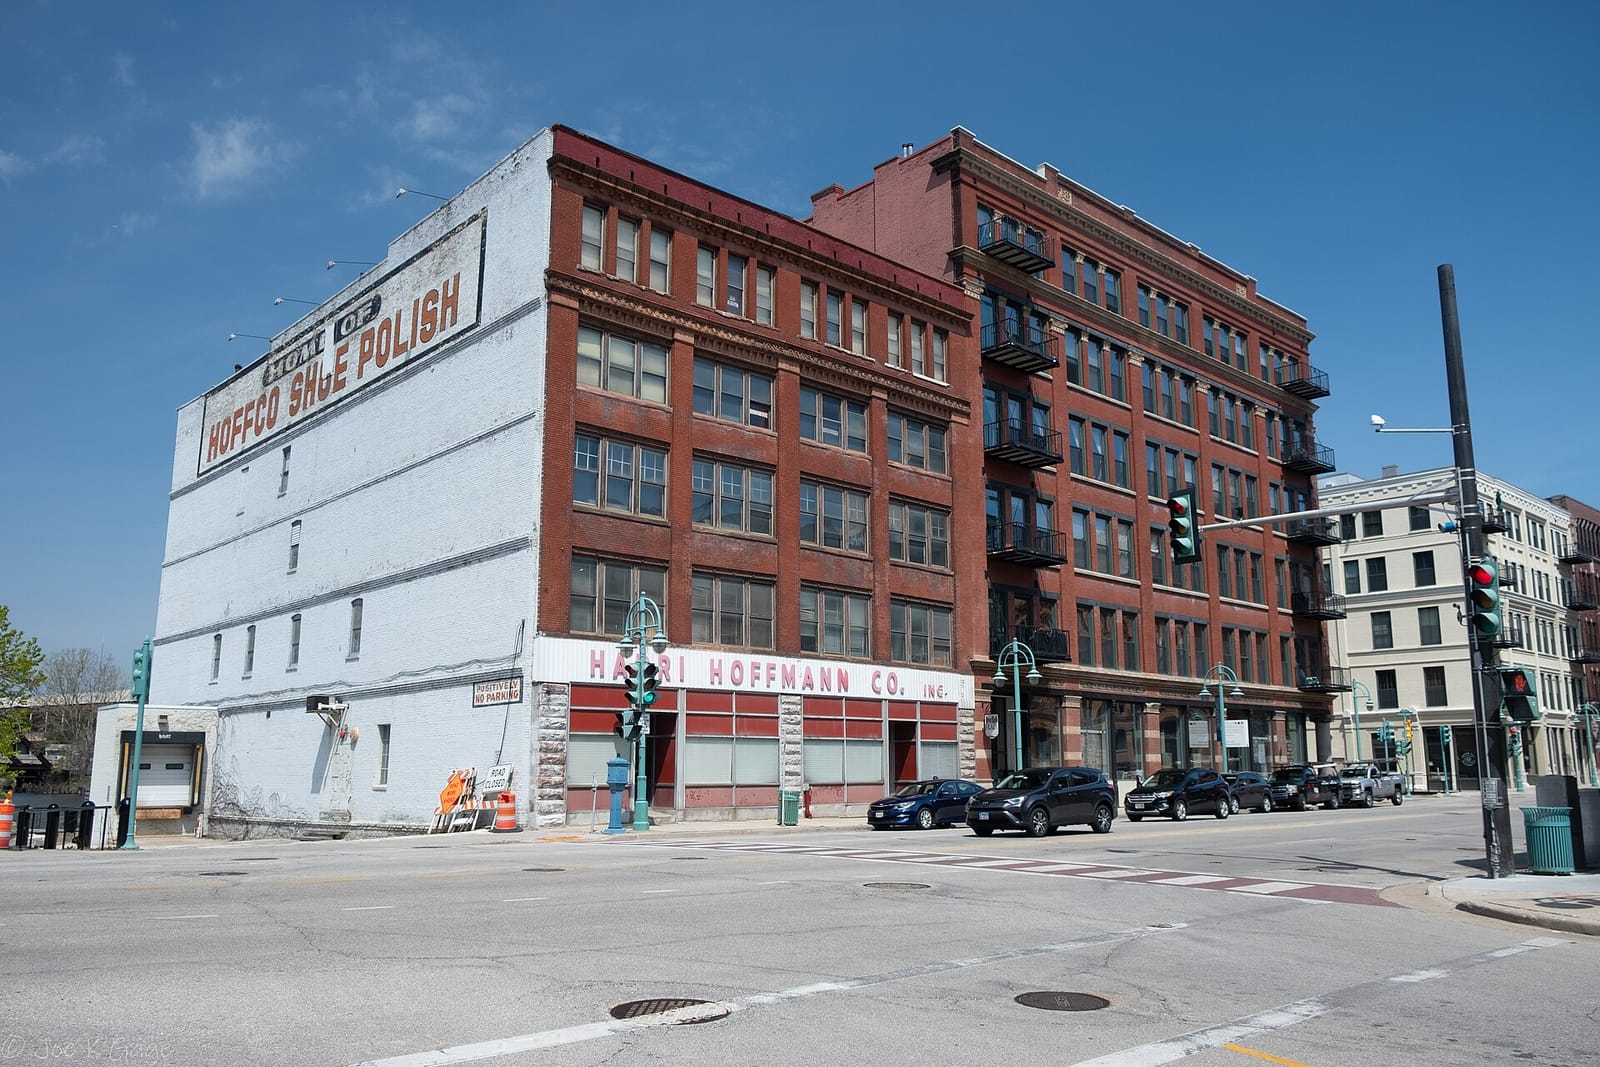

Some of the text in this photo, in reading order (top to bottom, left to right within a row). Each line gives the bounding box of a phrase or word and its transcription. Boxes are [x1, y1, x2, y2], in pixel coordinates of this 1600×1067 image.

[206, 385, 280, 463] HOFFCO
[357, 272, 461, 380] POLISH
[590, 649, 685, 682] HARI
[709, 658, 849, 693] HOFFMANN
[871, 670, 904, 696] CO.
[476, 680, 518, 692] POSITIVELY
[475, 690, 518, 703] NO PARKING
[485, 778, 506, 788] CLOSED
